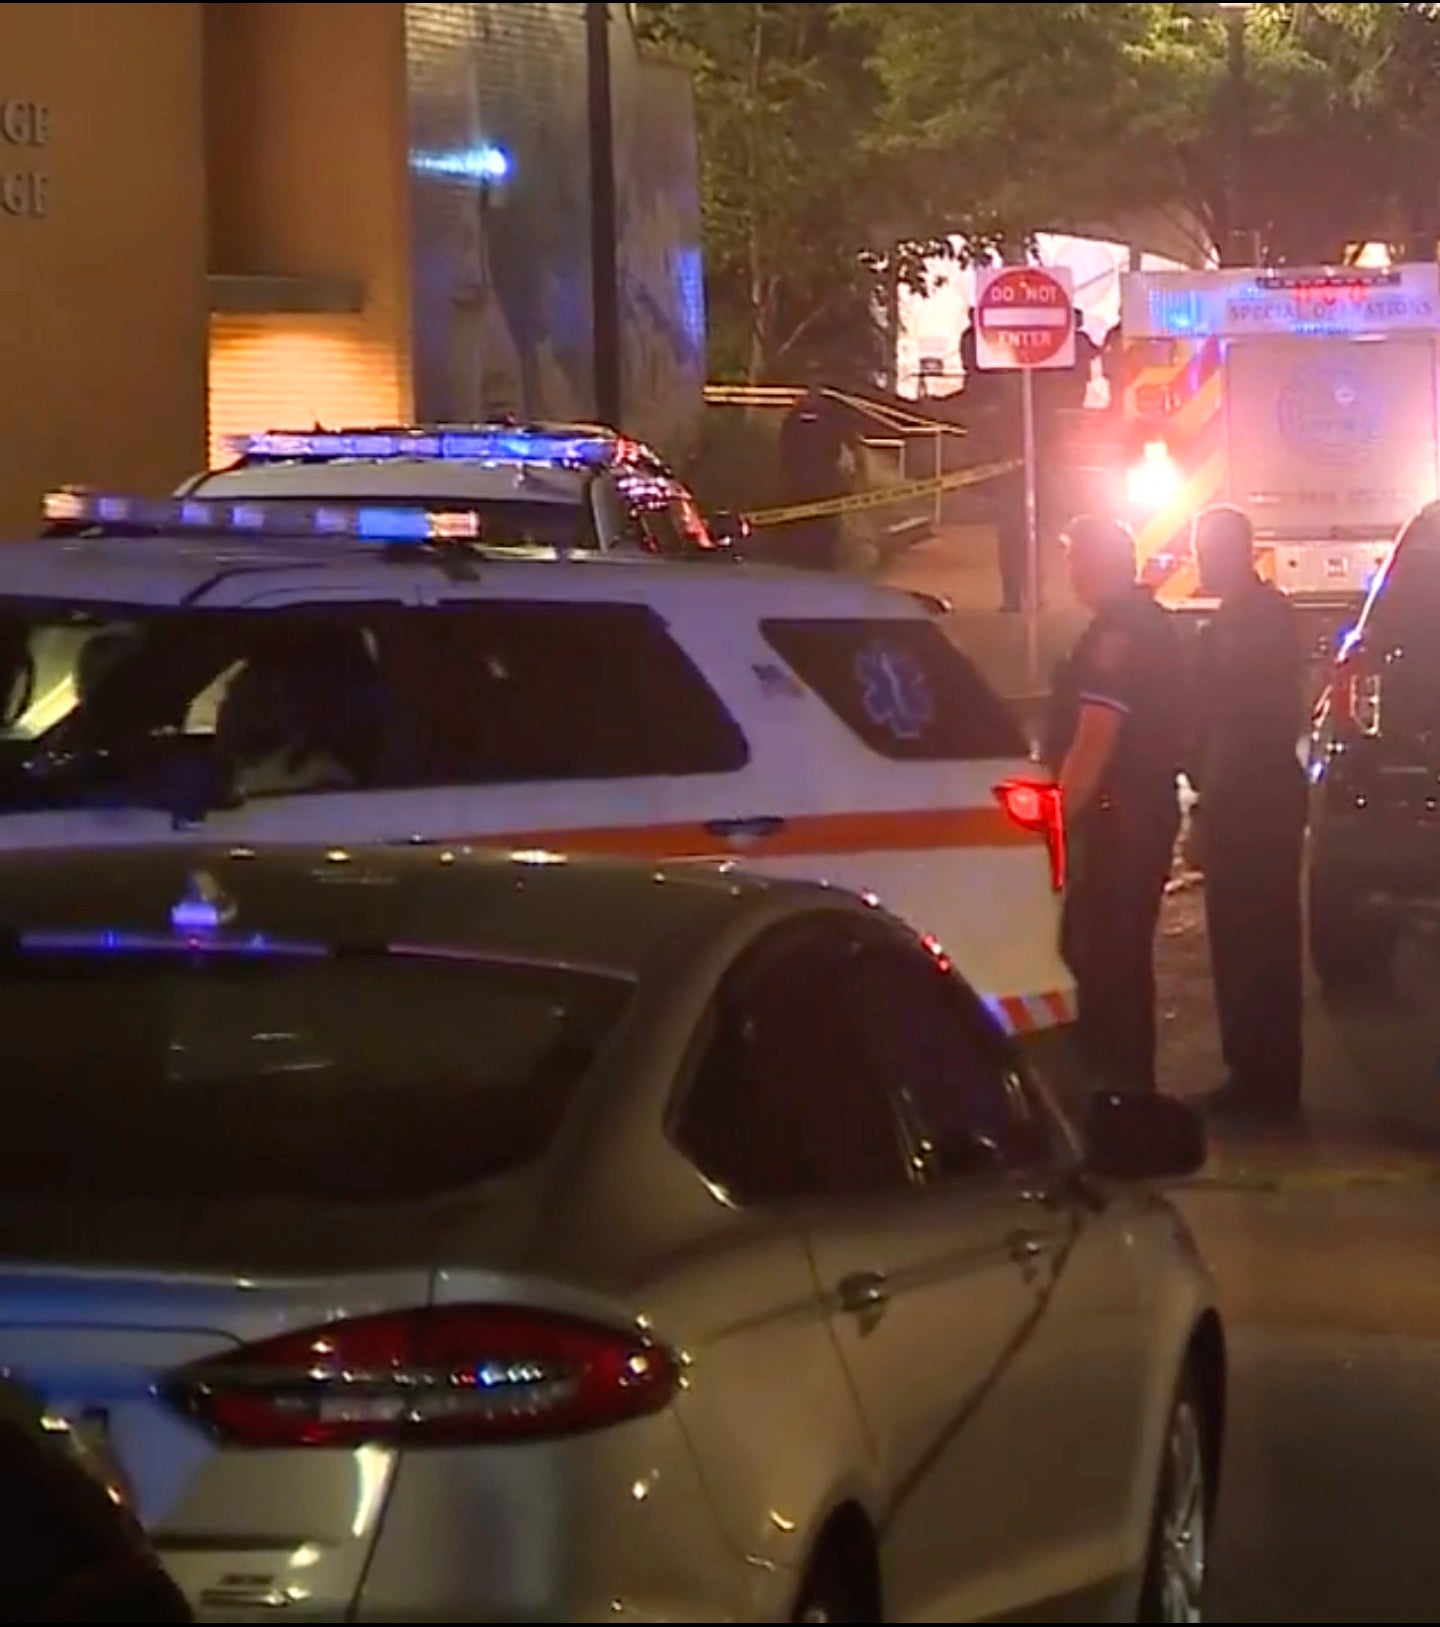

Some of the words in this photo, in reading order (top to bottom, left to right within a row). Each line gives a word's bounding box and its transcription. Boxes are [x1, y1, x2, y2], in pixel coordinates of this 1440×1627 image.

[991, 285, 1014, 301] DO
[1025, 285, 1057, 302] NOT
[1313, 299, 1433, 320] OATIONS
[997, 330, 1052, 347] ENTER
